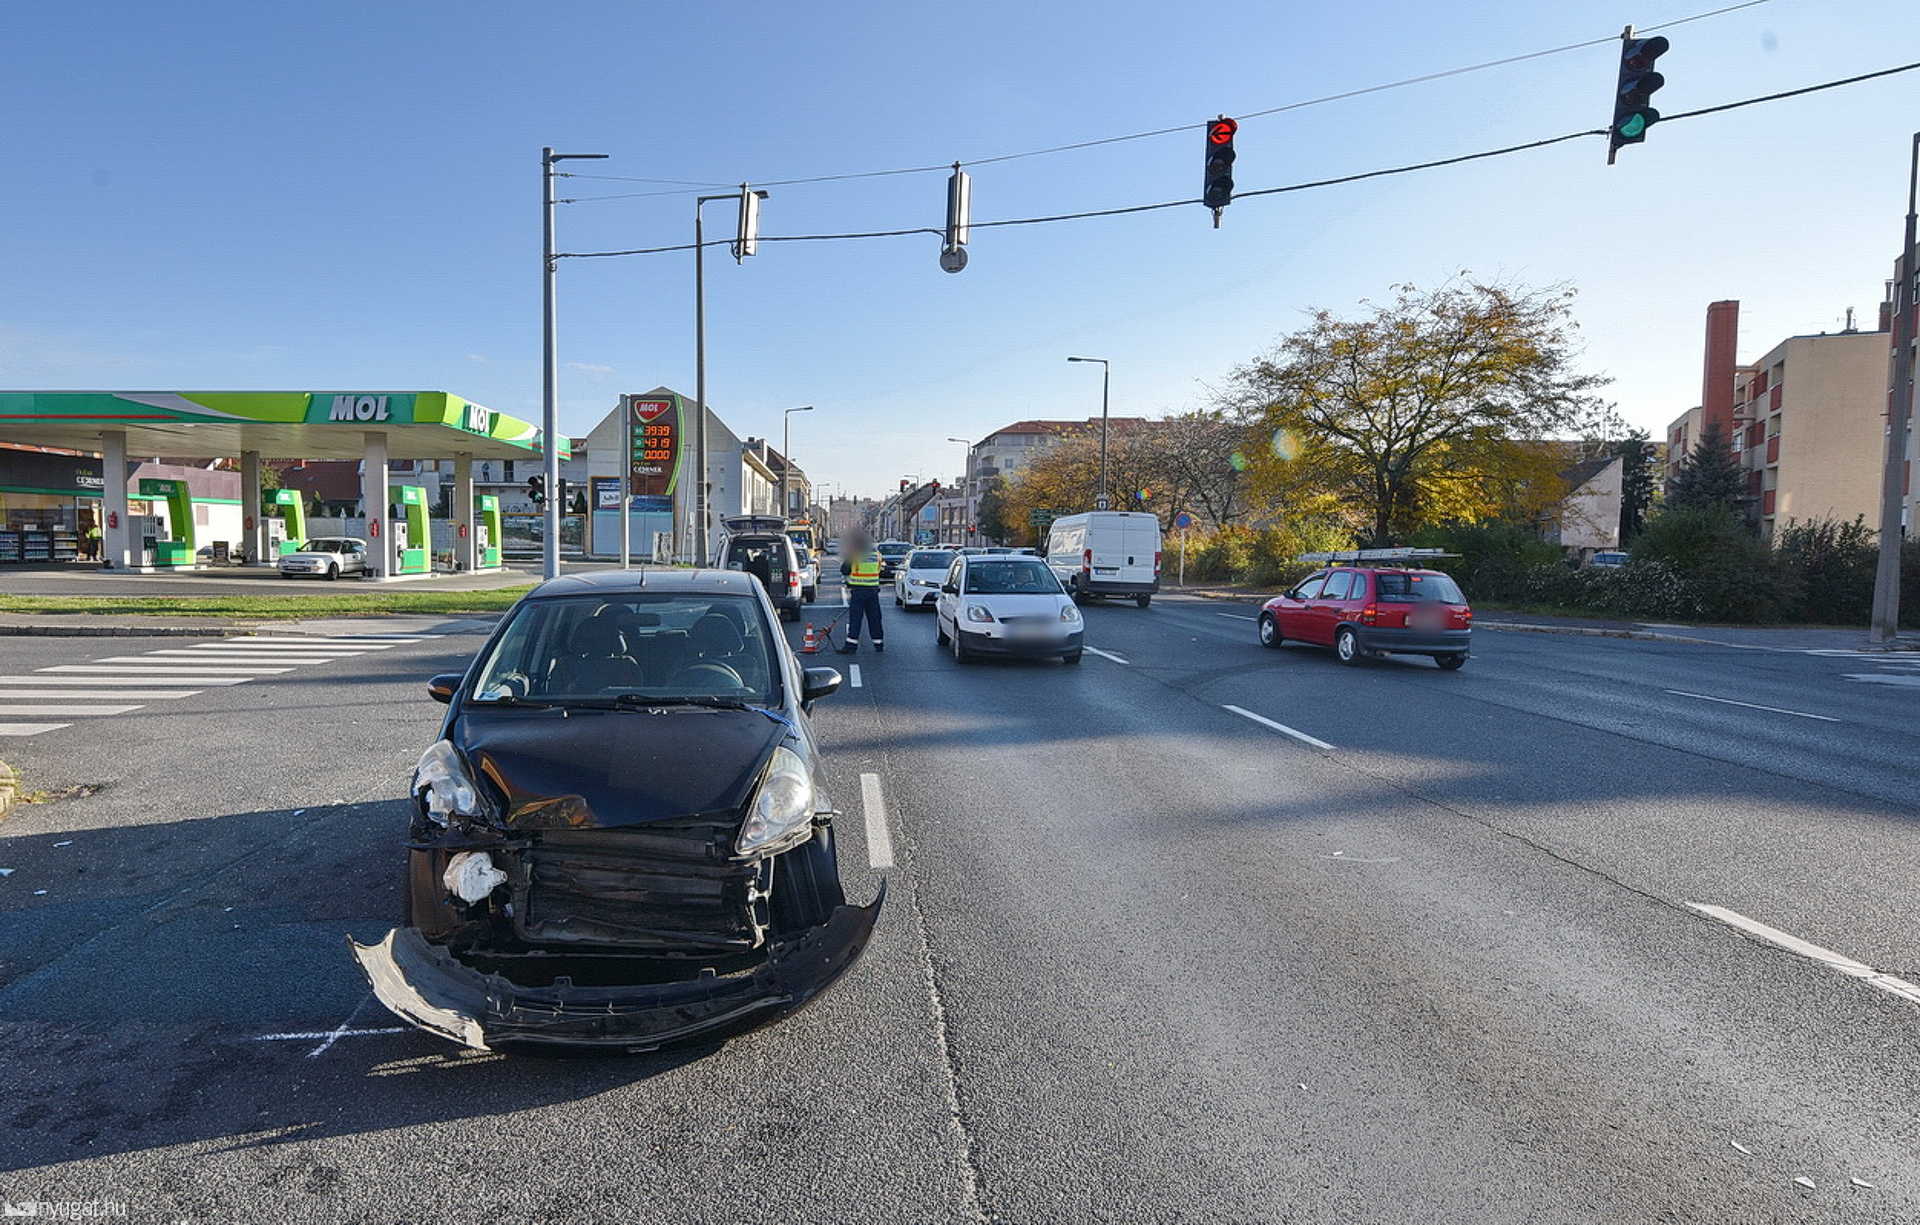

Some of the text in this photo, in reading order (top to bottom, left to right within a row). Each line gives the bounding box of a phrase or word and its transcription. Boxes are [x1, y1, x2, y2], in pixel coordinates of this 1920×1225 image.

[329, 395, 389, 421] MOL
[640, 402, 659, 412] MOL
[645, 425, 671, 436] 3939
[645, 438, 671, 448] 4319
[644, 449, 671, 460] 0000
